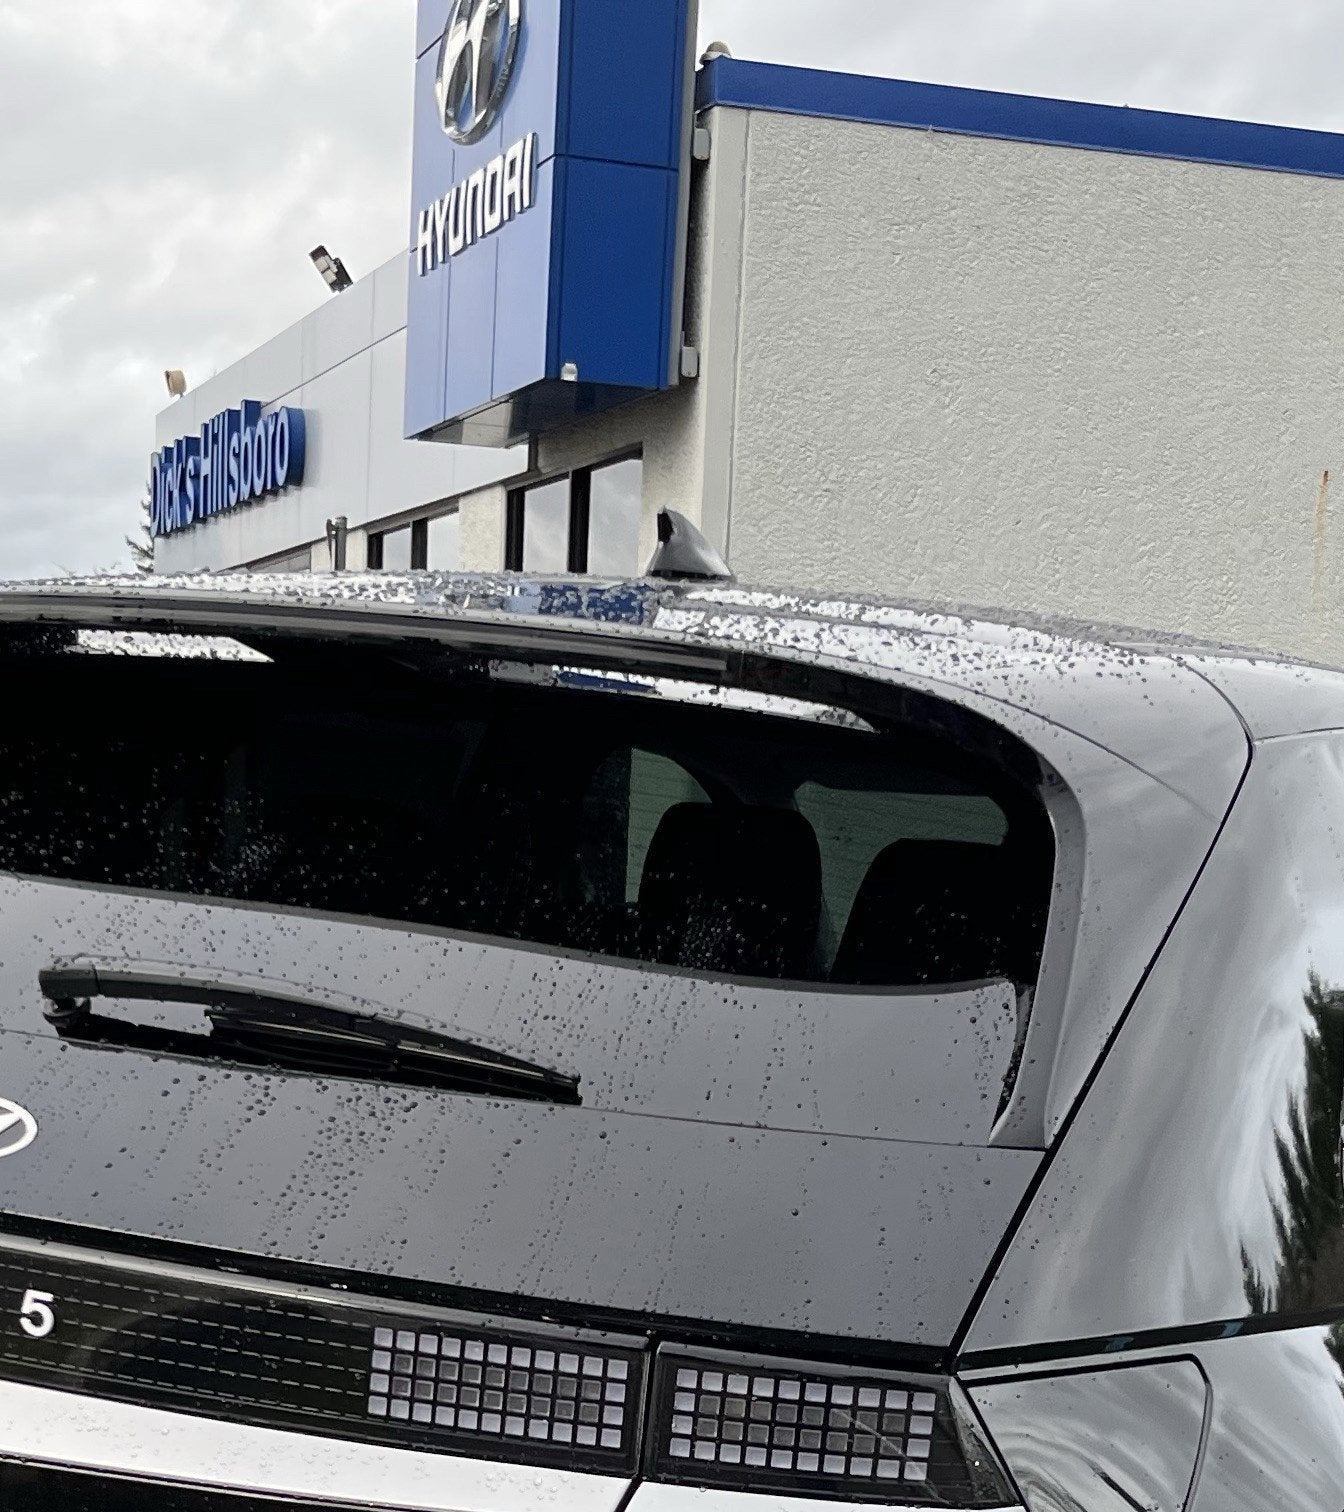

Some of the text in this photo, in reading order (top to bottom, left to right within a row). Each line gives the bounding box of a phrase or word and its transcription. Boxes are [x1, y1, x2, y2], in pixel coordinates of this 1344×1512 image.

[417, 132, 537, 277] HYUNDAI
[150, 399, 301, 538] Dick's Hillsboro
[18, 1288, 56, 1338] 5
